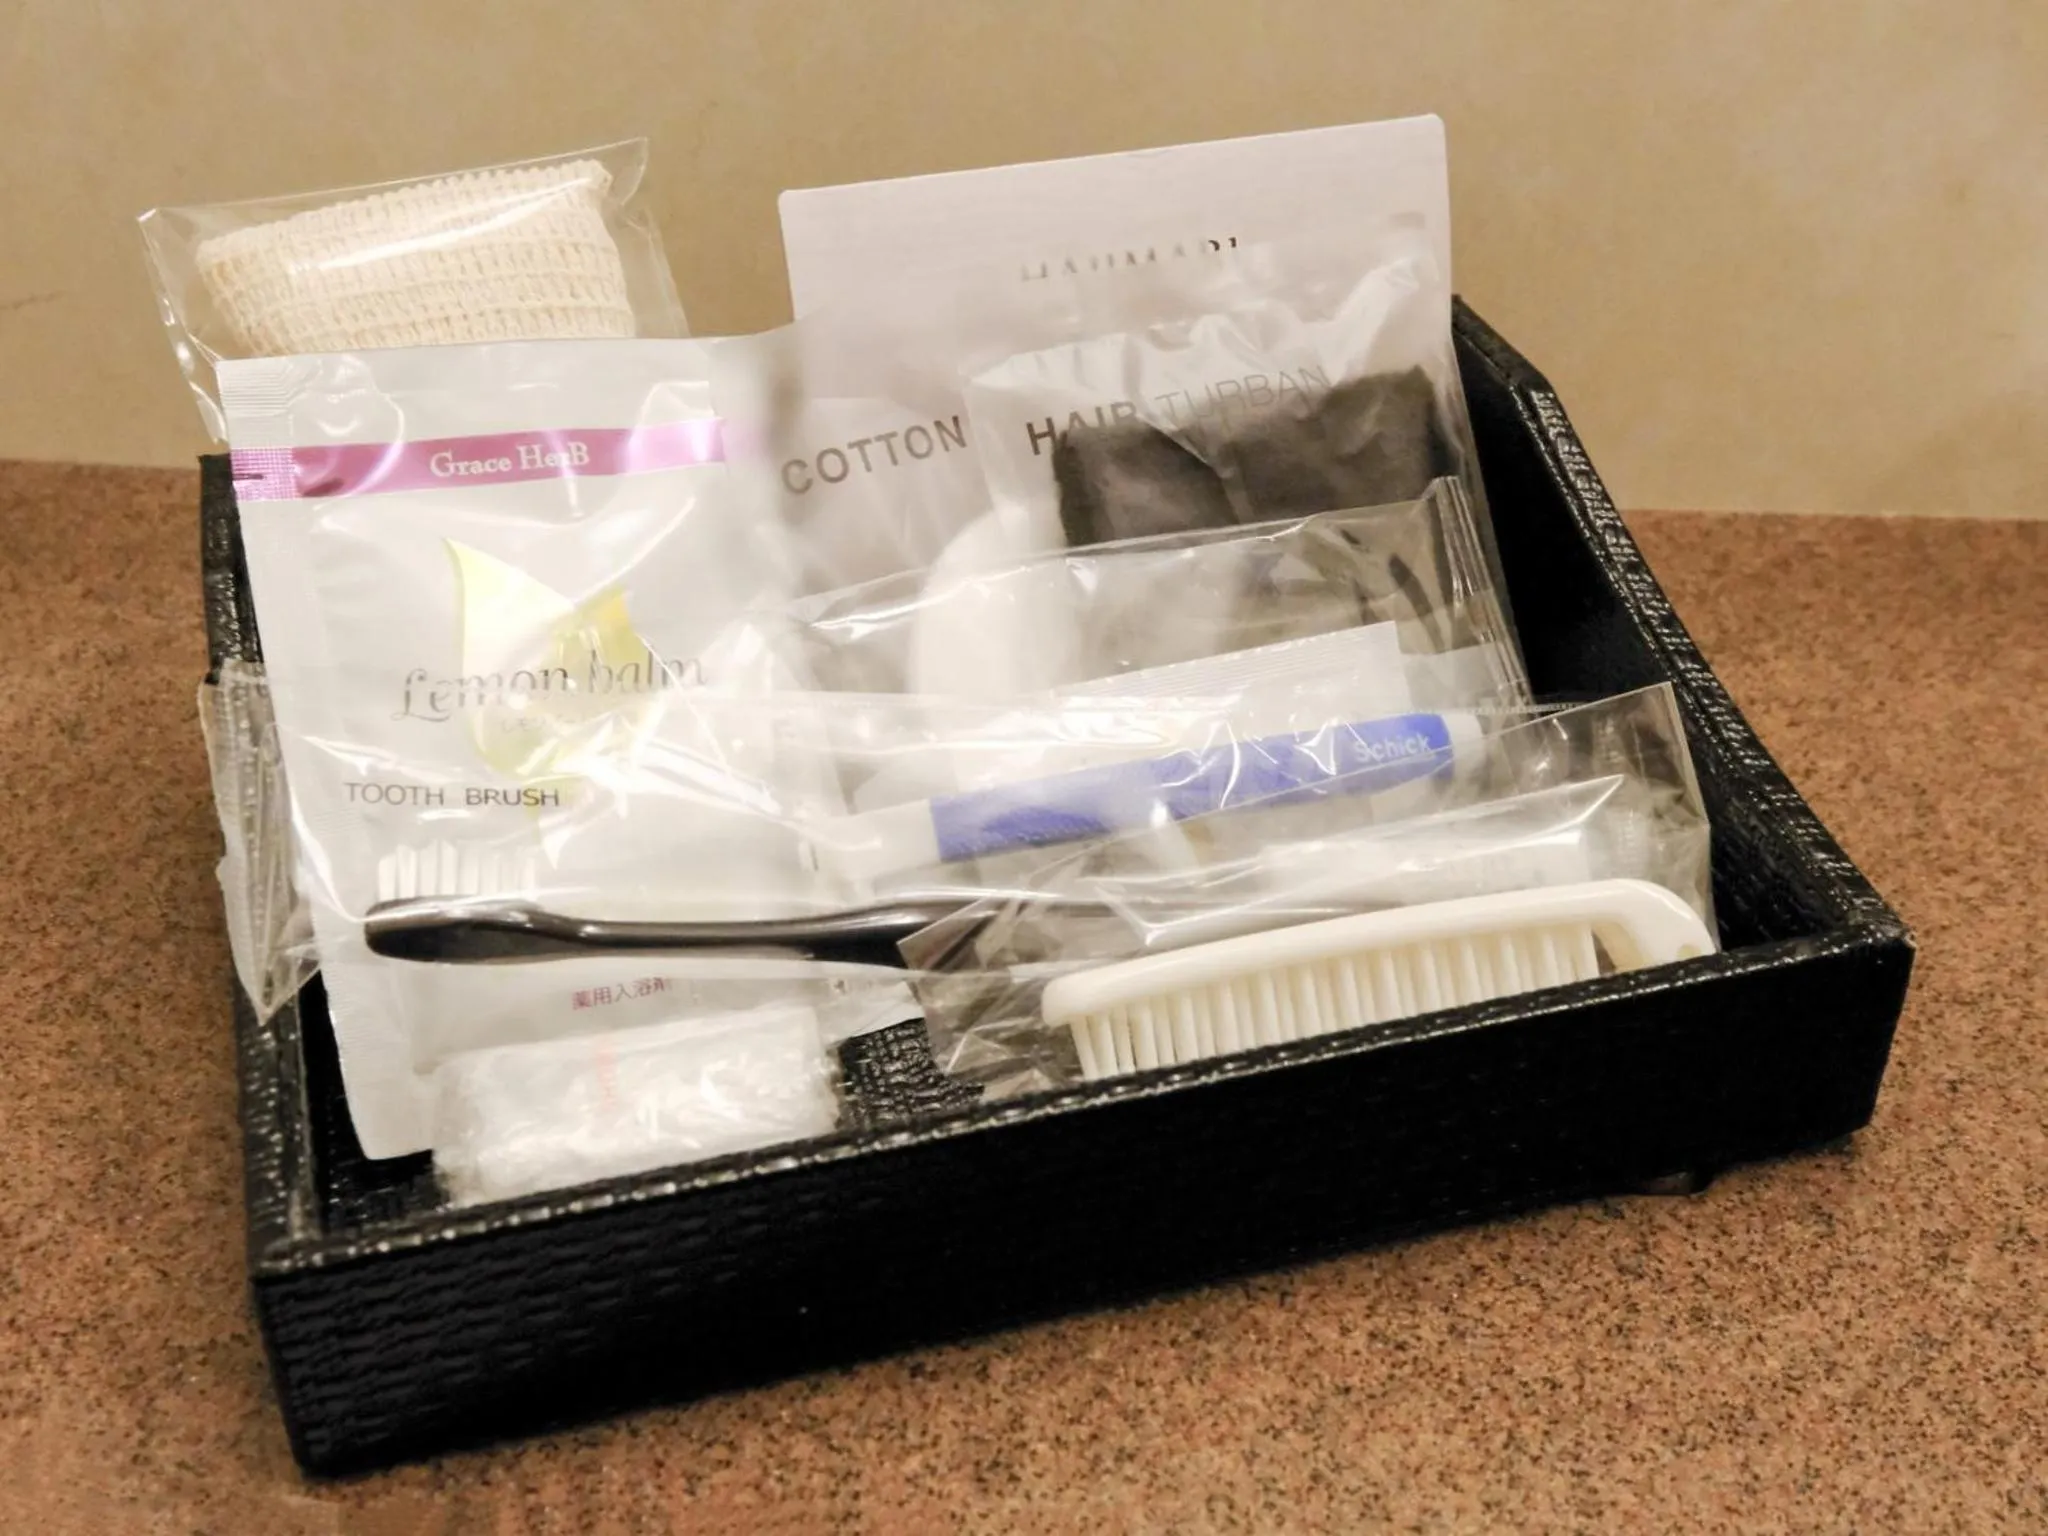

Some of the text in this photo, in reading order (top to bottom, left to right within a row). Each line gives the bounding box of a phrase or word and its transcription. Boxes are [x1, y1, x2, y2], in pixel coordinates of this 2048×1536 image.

[1155, 366, 1331, 420] TURBAN
[430, 450, 512, 477] Grace
[781, 415, 967, 495] COTTON
[391, 649, 706, 722] Lemon balm
[1355, 732, 1430, 762] Schick
[345, 783, 560, 807] TOOTH BRUSH
